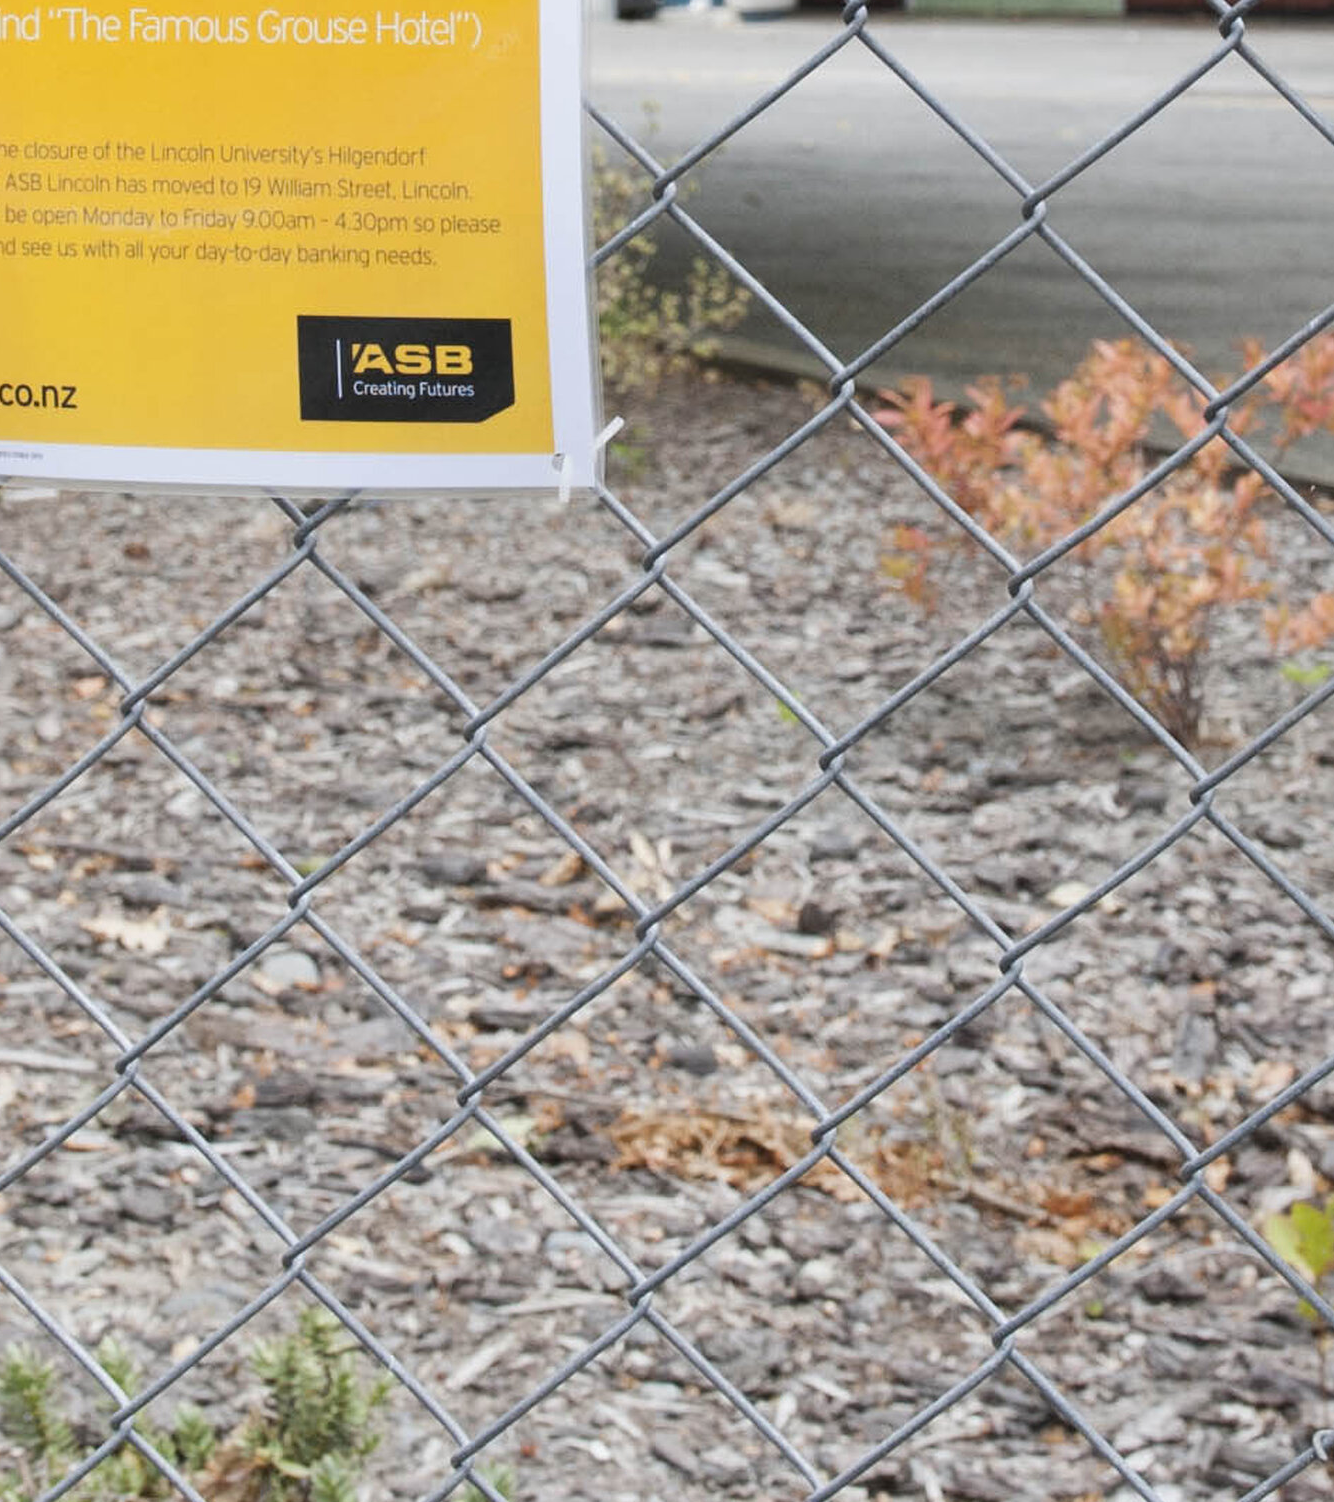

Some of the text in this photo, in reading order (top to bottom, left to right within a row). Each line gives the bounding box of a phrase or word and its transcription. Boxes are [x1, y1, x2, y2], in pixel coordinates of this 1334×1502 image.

[130, 7, 249, 43] Famous
[257, 8, 367, 44] Grouse
[23, 142, 87, 160] closure
[93, 142, 111, 160] of
[117, 142, 145, 160] the
[151, 142, 214, 162] Lincoln
[220, 145, 323, 165] University's
[329, 146, 427, 169] Hilgendorf
[5, 173, 42, 191] ASB
[47, 174, 109, 193] Lincoln
[117, 175, 147, 193] has
[153, 177, 215, 195] moved
[221, 178, 238, 196] to
[244, 178, 261, 196] 19
[268, 179, 331, 198] William
[338, 180, 397, 200] Street,
[403, 181, 471, 200] Lincoln.
[5, 205, 26, 223] be
[32, 210, 77, 226] open
[83, 208, 155, 228] Monday
[160, 208, 177, 227] to
[182, 209, 237, 231] Friday
[243, 210, 315, 229] 9.00am
[335, 212, 407, 234] 4.30pm
[415, 216, 435, 232] so
[441, 216, 501, 236] please
[22, 240, 52, 256] see
[57, 242, 78, 256] us
[83, 240, 119, 258] with
[125, 240, 143, 258] all
[149, 243, 189, 263] your
[195, 242, 291, 265] day-to-day
[297, 246, 369, 268] banking
[376, 246, 437, 266] needs.
[352, 344, 473, 374] ASB
[353, 380, 474, 399] Creating Futures
